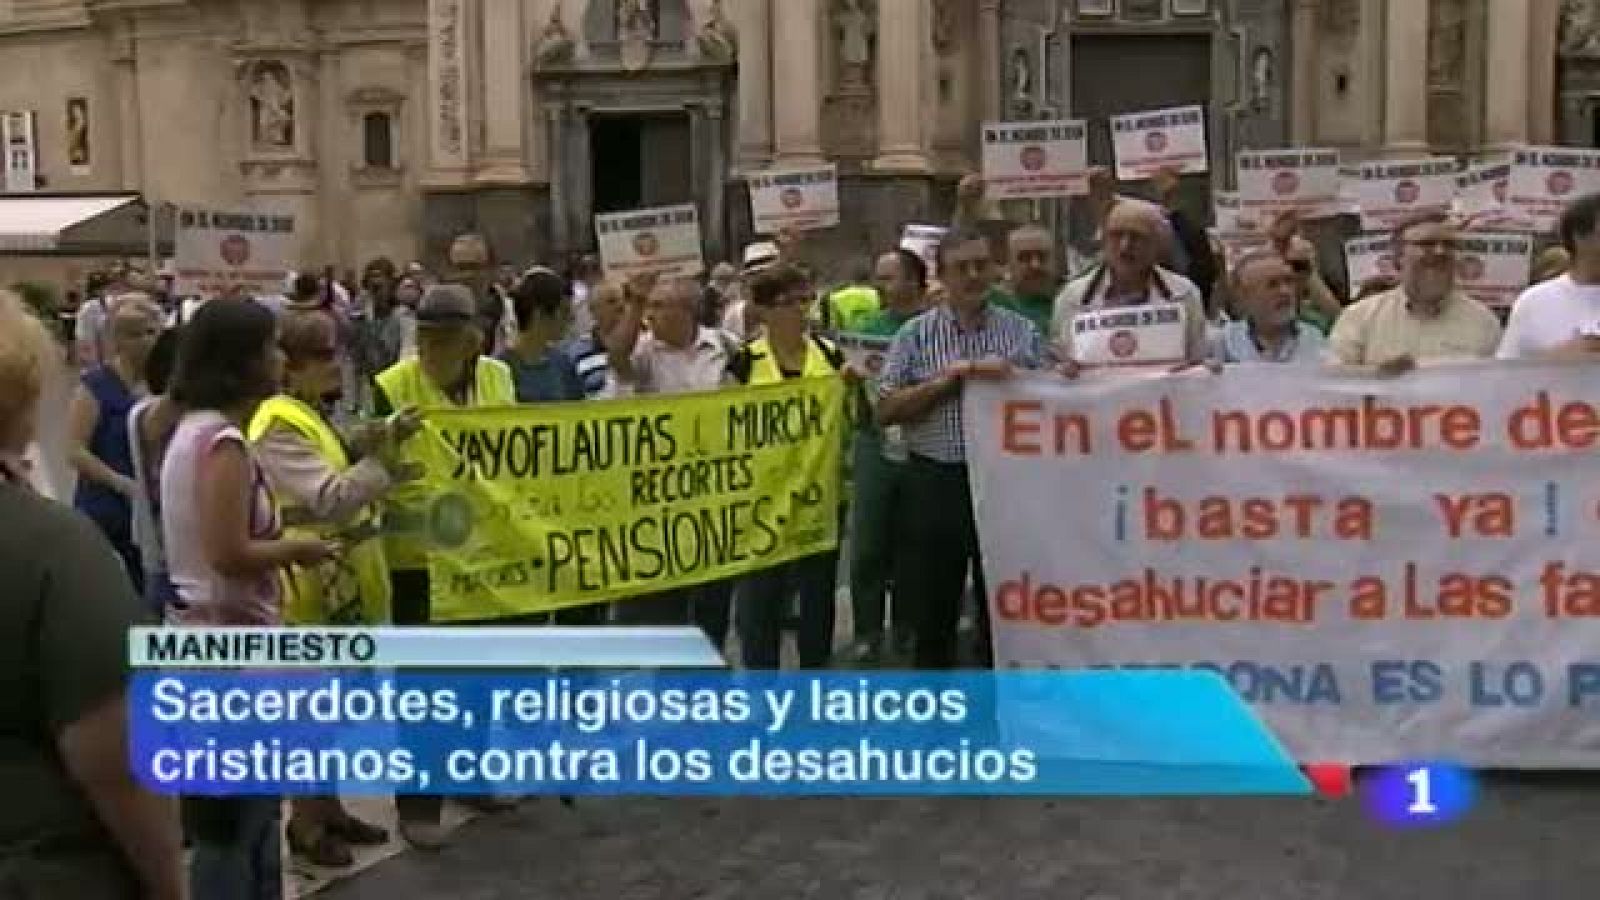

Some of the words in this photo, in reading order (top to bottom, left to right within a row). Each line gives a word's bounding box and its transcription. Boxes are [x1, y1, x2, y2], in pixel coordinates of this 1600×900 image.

[440, 413, 677, 480] YAYOFLAUTAS
[728, 393, 823, 449] MURCIA
[1002, 401, 1091, 455] En
[1213, 394, 1481, 451] nombre
[1508, 390, 1600, 450] de
[631, 453, 753, 507] RECORTES
[996, 566, 1335, 627] desahuciar
[1350, 575, 1386, 620] a
[1370, 659, 1442, 705] ES
[1469, 660, 1543, 706] LO
